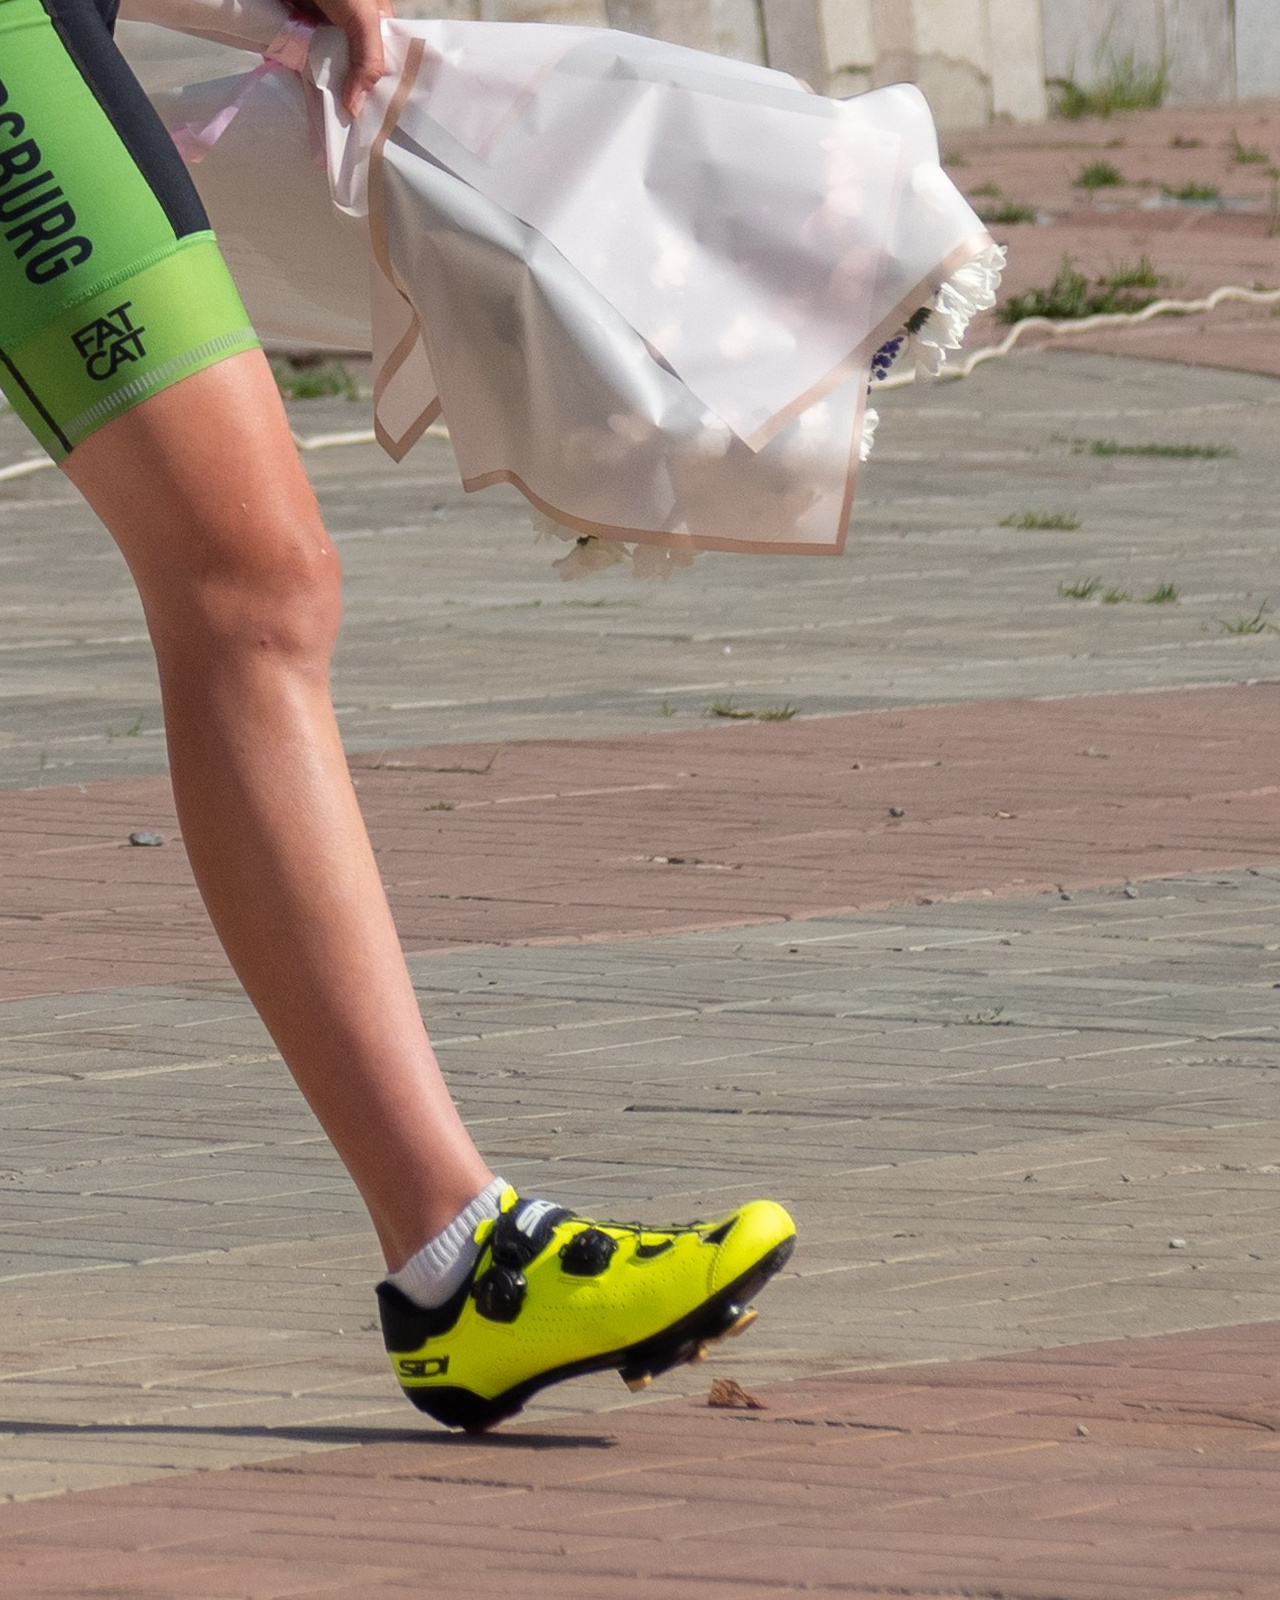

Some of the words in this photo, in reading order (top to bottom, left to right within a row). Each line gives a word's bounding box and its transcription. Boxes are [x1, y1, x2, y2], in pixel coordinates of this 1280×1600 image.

[71, 300, 133, 361] FAT
[86, 325, 147, 382] CAT
[399, 1354, 450, 1378] SIDI
